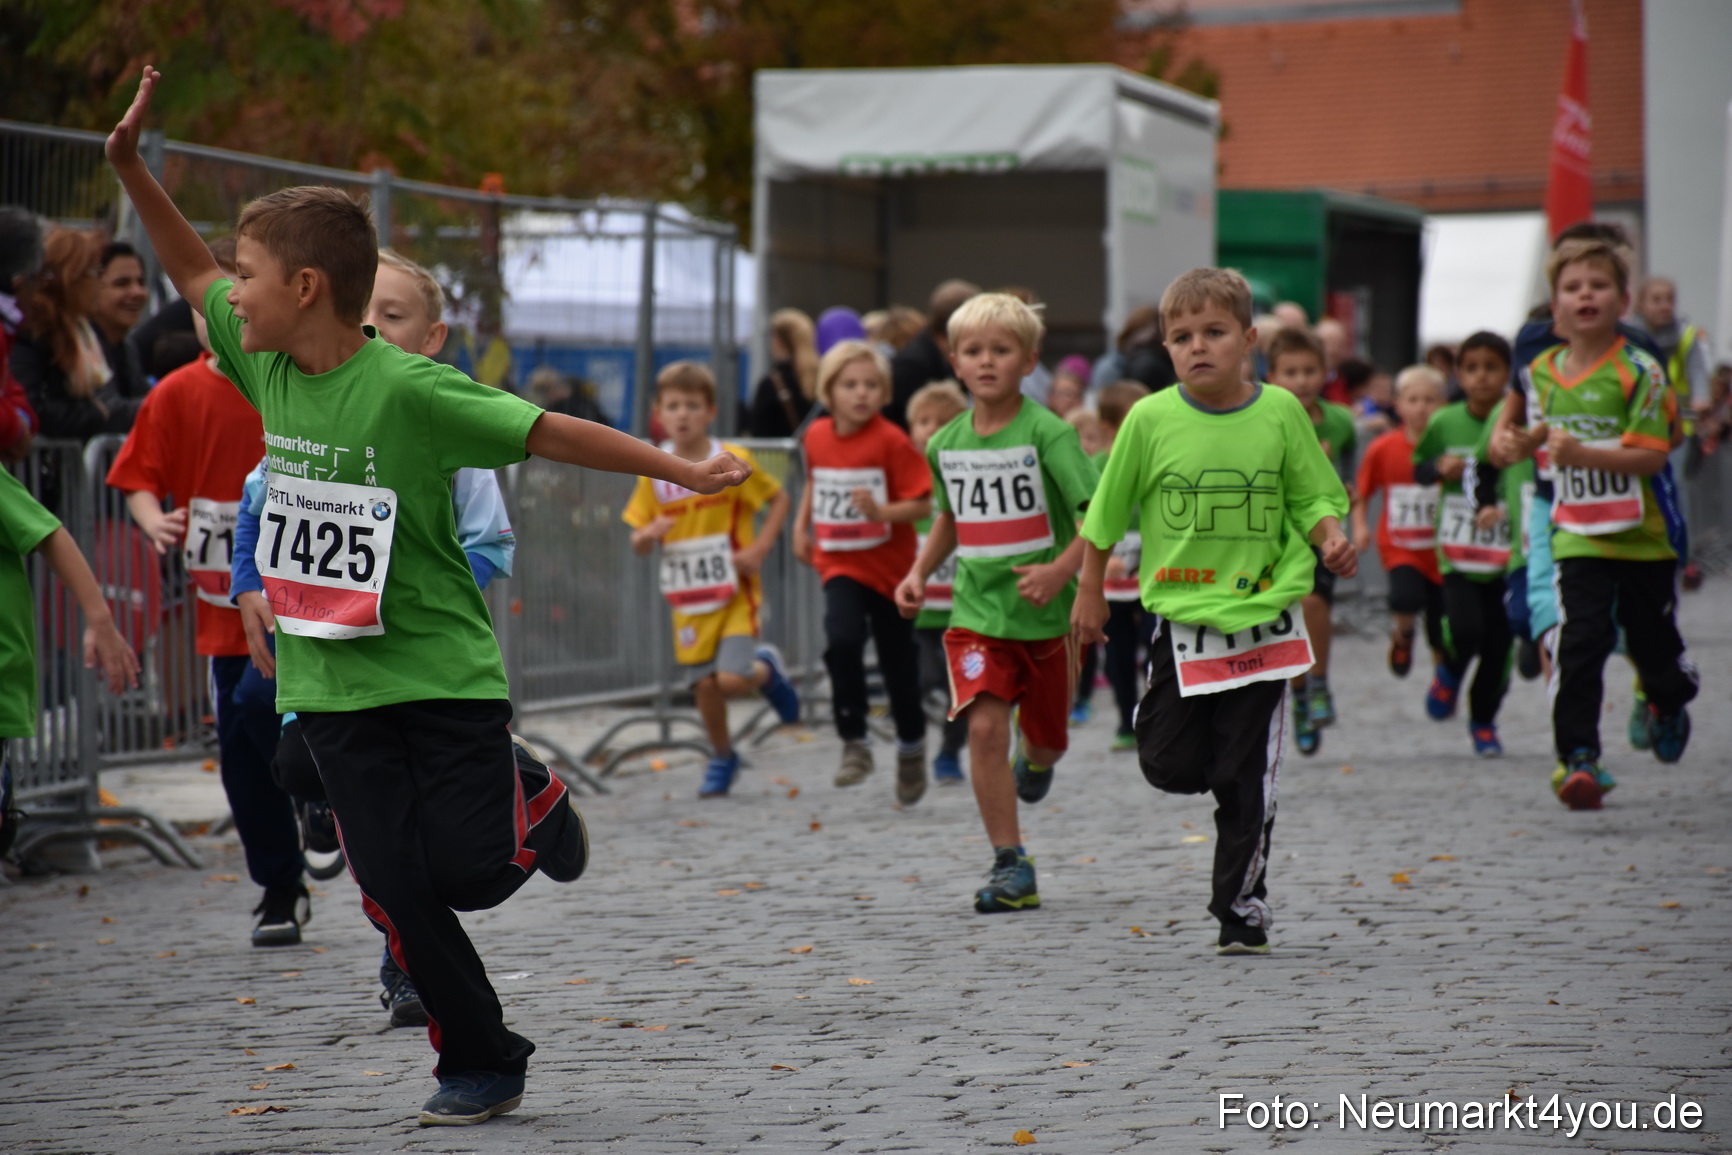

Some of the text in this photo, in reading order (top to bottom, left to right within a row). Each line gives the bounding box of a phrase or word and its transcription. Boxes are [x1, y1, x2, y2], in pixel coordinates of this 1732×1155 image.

[296, 494, 364, 516] Neumarkt
[950, 474, 1036, 517] 7416
[267, 512, 375, 583] 7425
[1226, 653, 1264, 675] Toni
